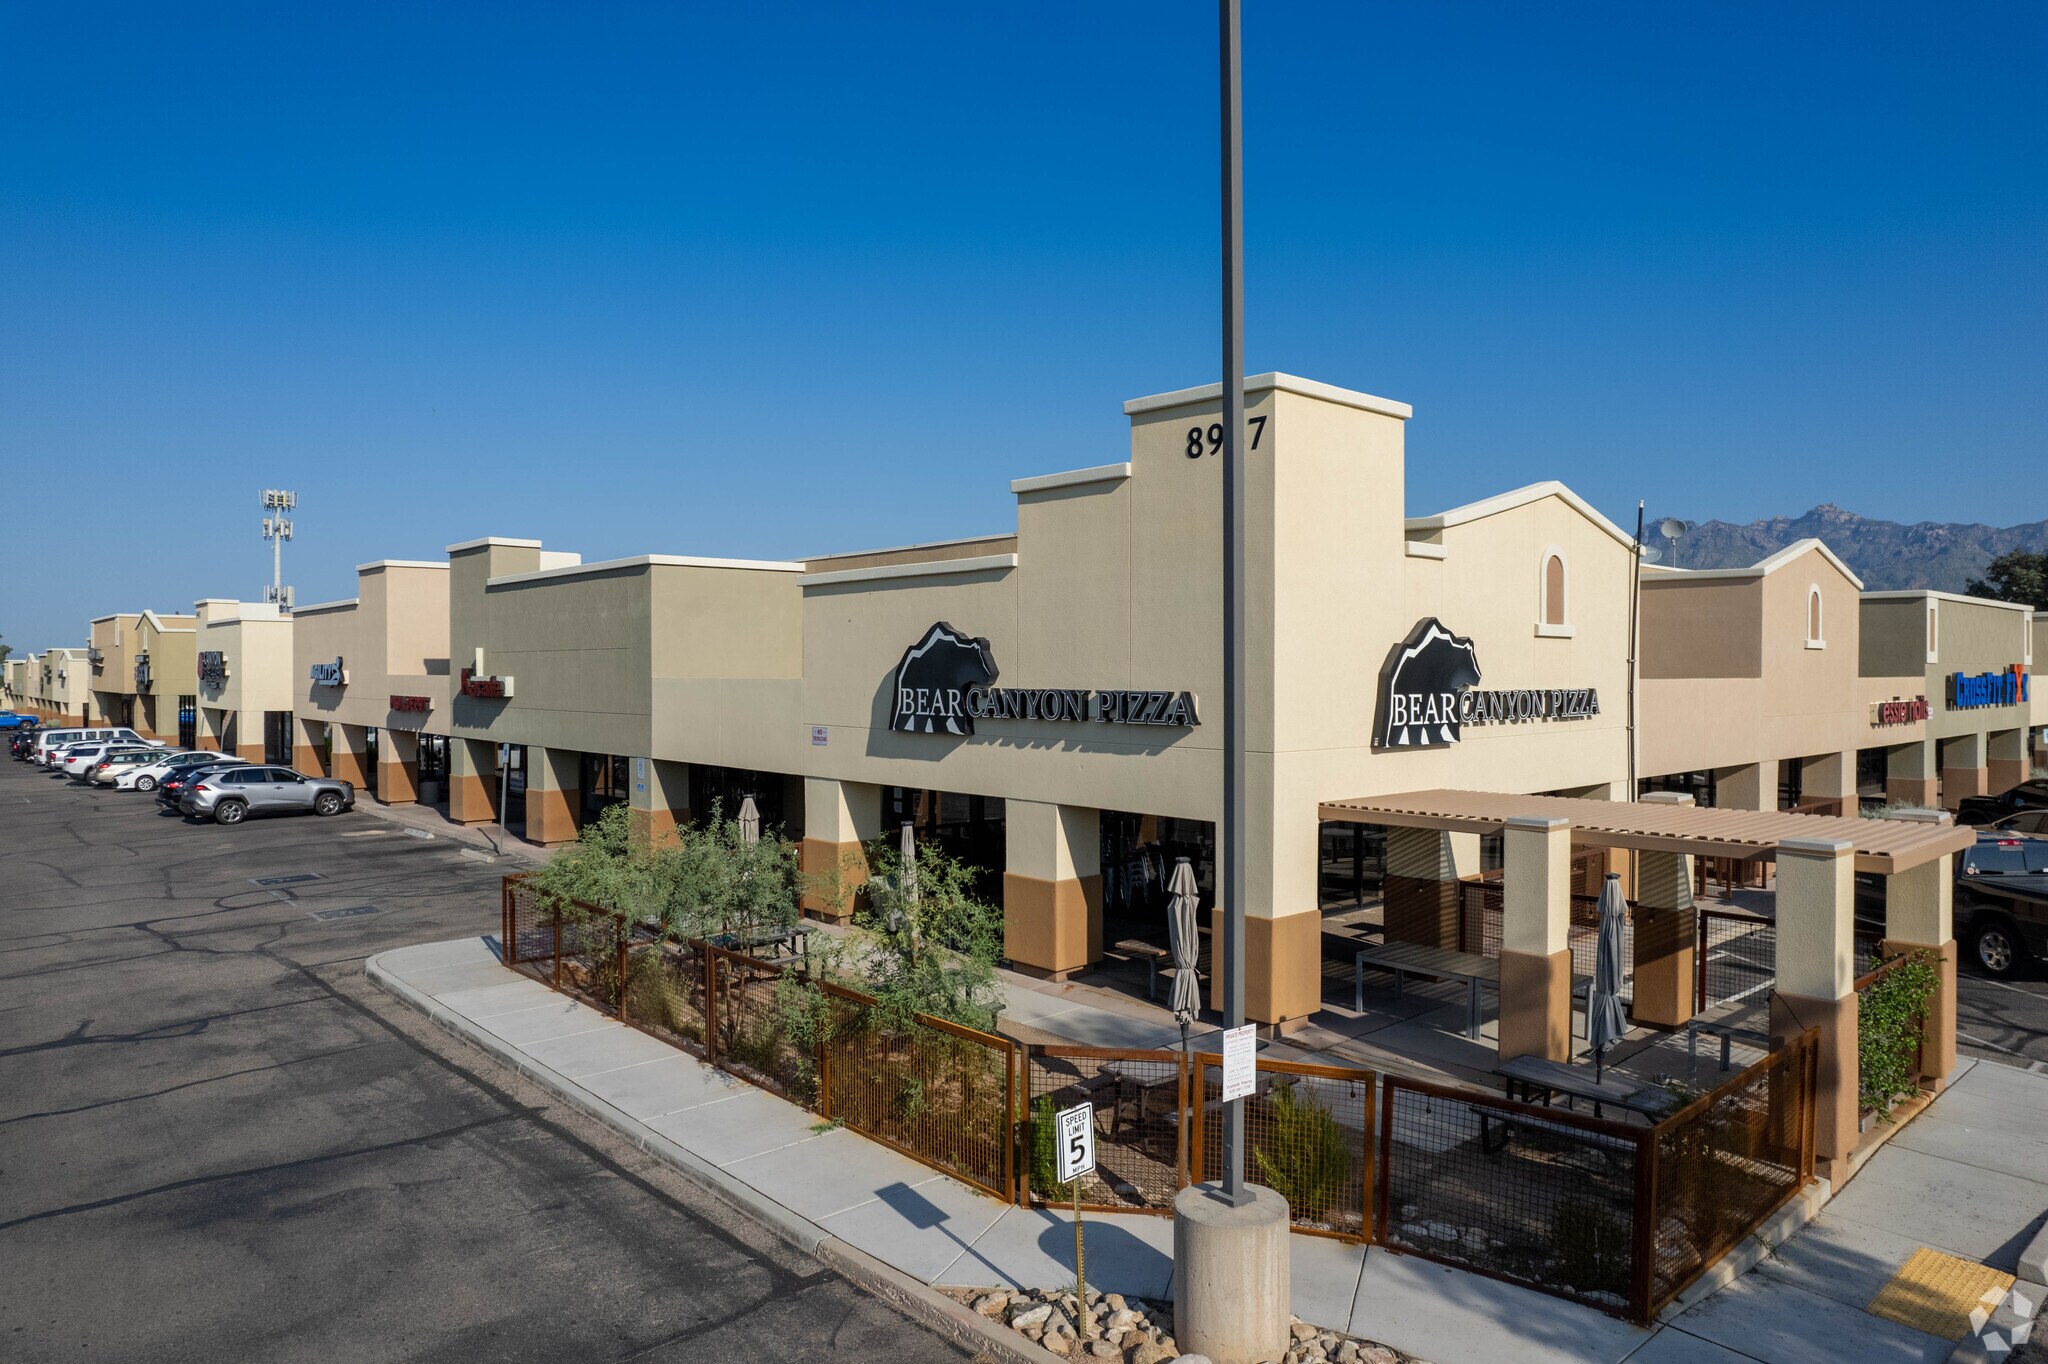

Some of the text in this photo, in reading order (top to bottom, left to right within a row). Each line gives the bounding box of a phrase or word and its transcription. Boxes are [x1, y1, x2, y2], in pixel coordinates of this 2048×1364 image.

[1185, 415, 1267, 460] 897
[311, 663, 333, 680] AGILITY
[901, 688, 1200, 726] BEAR CANYON PIZZA
[1393, 688, 1600, 726] BEAR CANYON PIZZA
[1883, 702, 1907, 723] essie
[1066, 1111, 1087, 1127] SPEED
[1068, 1122, 1085, 1137] LIMIT
[1071, 1134, 1085, 1165] 5
[1072, 1164, 1085, 1174] MPH
